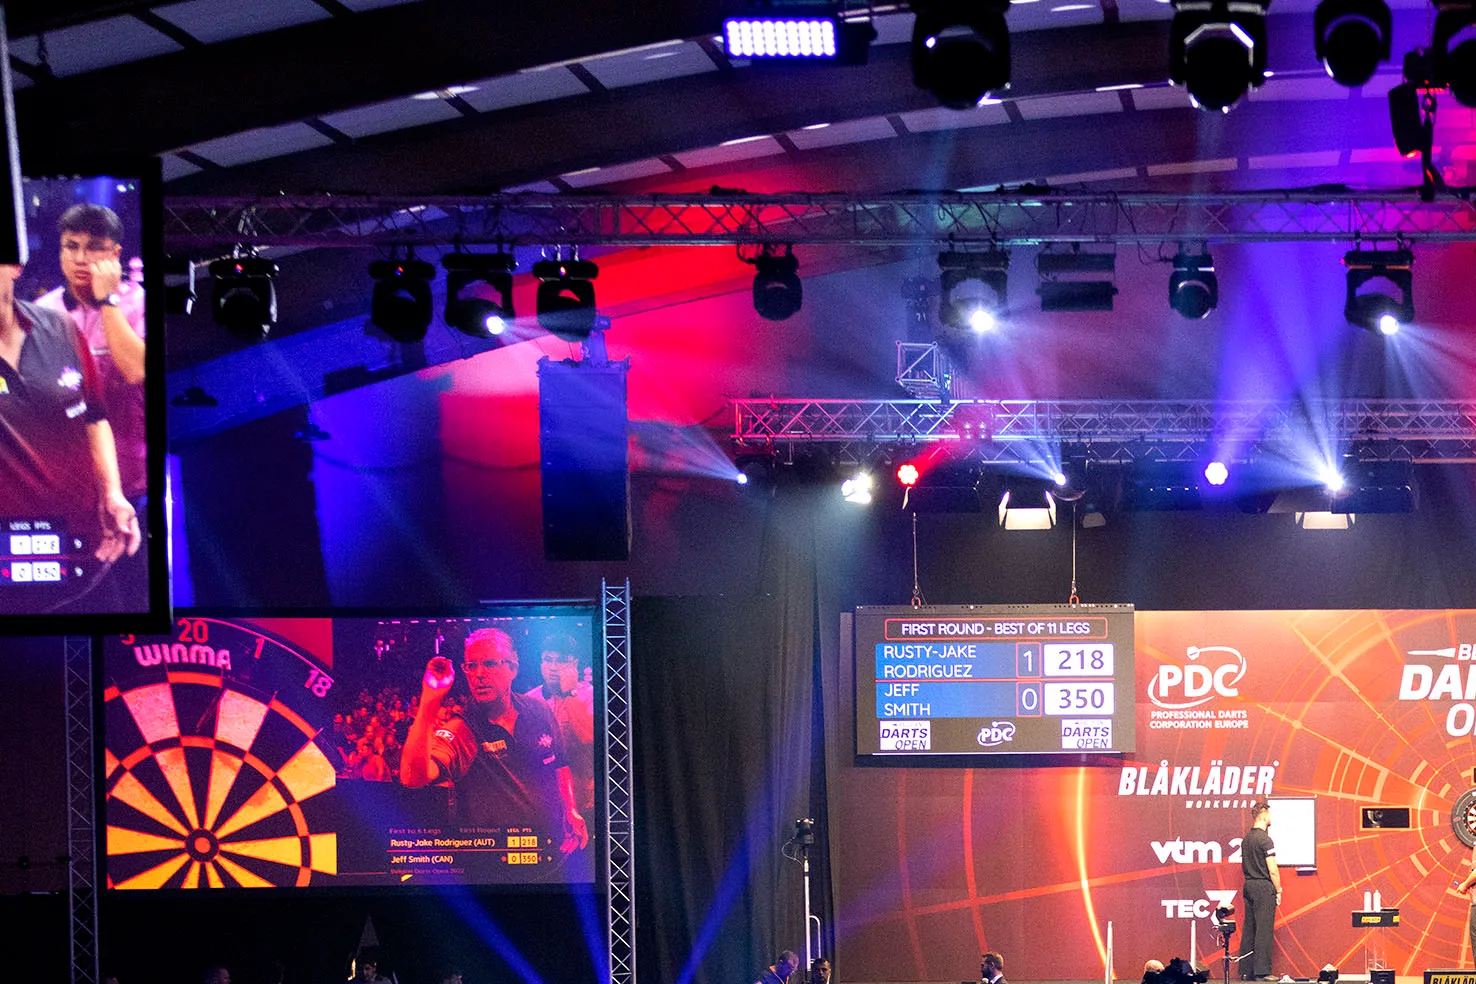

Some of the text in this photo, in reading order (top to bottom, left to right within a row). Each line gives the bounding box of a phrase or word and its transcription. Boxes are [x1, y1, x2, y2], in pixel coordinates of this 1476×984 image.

[178, 618, 209, 643] 20
[901, 622, 936, 635] FIRST
[938, 622, 984, 635] ROUND
[994, 622, 1025, 635] BEST
[1027, 622, 1045, 634] OF
[1047, 622, 1057, 634] 11
[1059, 622, 1090, 634] LEGS
[253, 638, 265, 660] 1
[884, 645, 976, 659] RUSTY-JAKE
[1023, 650, 1032, 672] 1
[1058, 650, 1104, 670] 218
[884, 664, 973, 679] RODRIGUEZ
[303, 669, 332, 698] 18
[1159, 664, 1239, 697] PDC
[884, 683, 920, 697] JEFF
[1021, 688, 1038, 710] 0
[1058, 688, 1105, 709] 350
[884, 703, 931, 717] SMITH
[1151, 710, 1247, 719] PROFESSIONAL DARTS
[1150, 720, 1249, 729] CORPORATION EUROPE
[881, 728, 928, 739] DARTS
[980, 728, 1013, 743] PDC
[1063, 726, 1110, 738] DARTS
[894, 739, 927, 750] OPEN
[1076, 738, 1109, 749] OPEN
[1118, 759, 1275, 795] BLÅKLÄDER
[390, 838, 496, 848] Rusty-Jake Rodriguez (AUT)
[522, 838, 536, 846] 218
[1151, 836, 1244, 864] vtm 2
[390, 855, 454, 864] Jeff Smith (CAN)
[522, 855, 537, 863] 350
